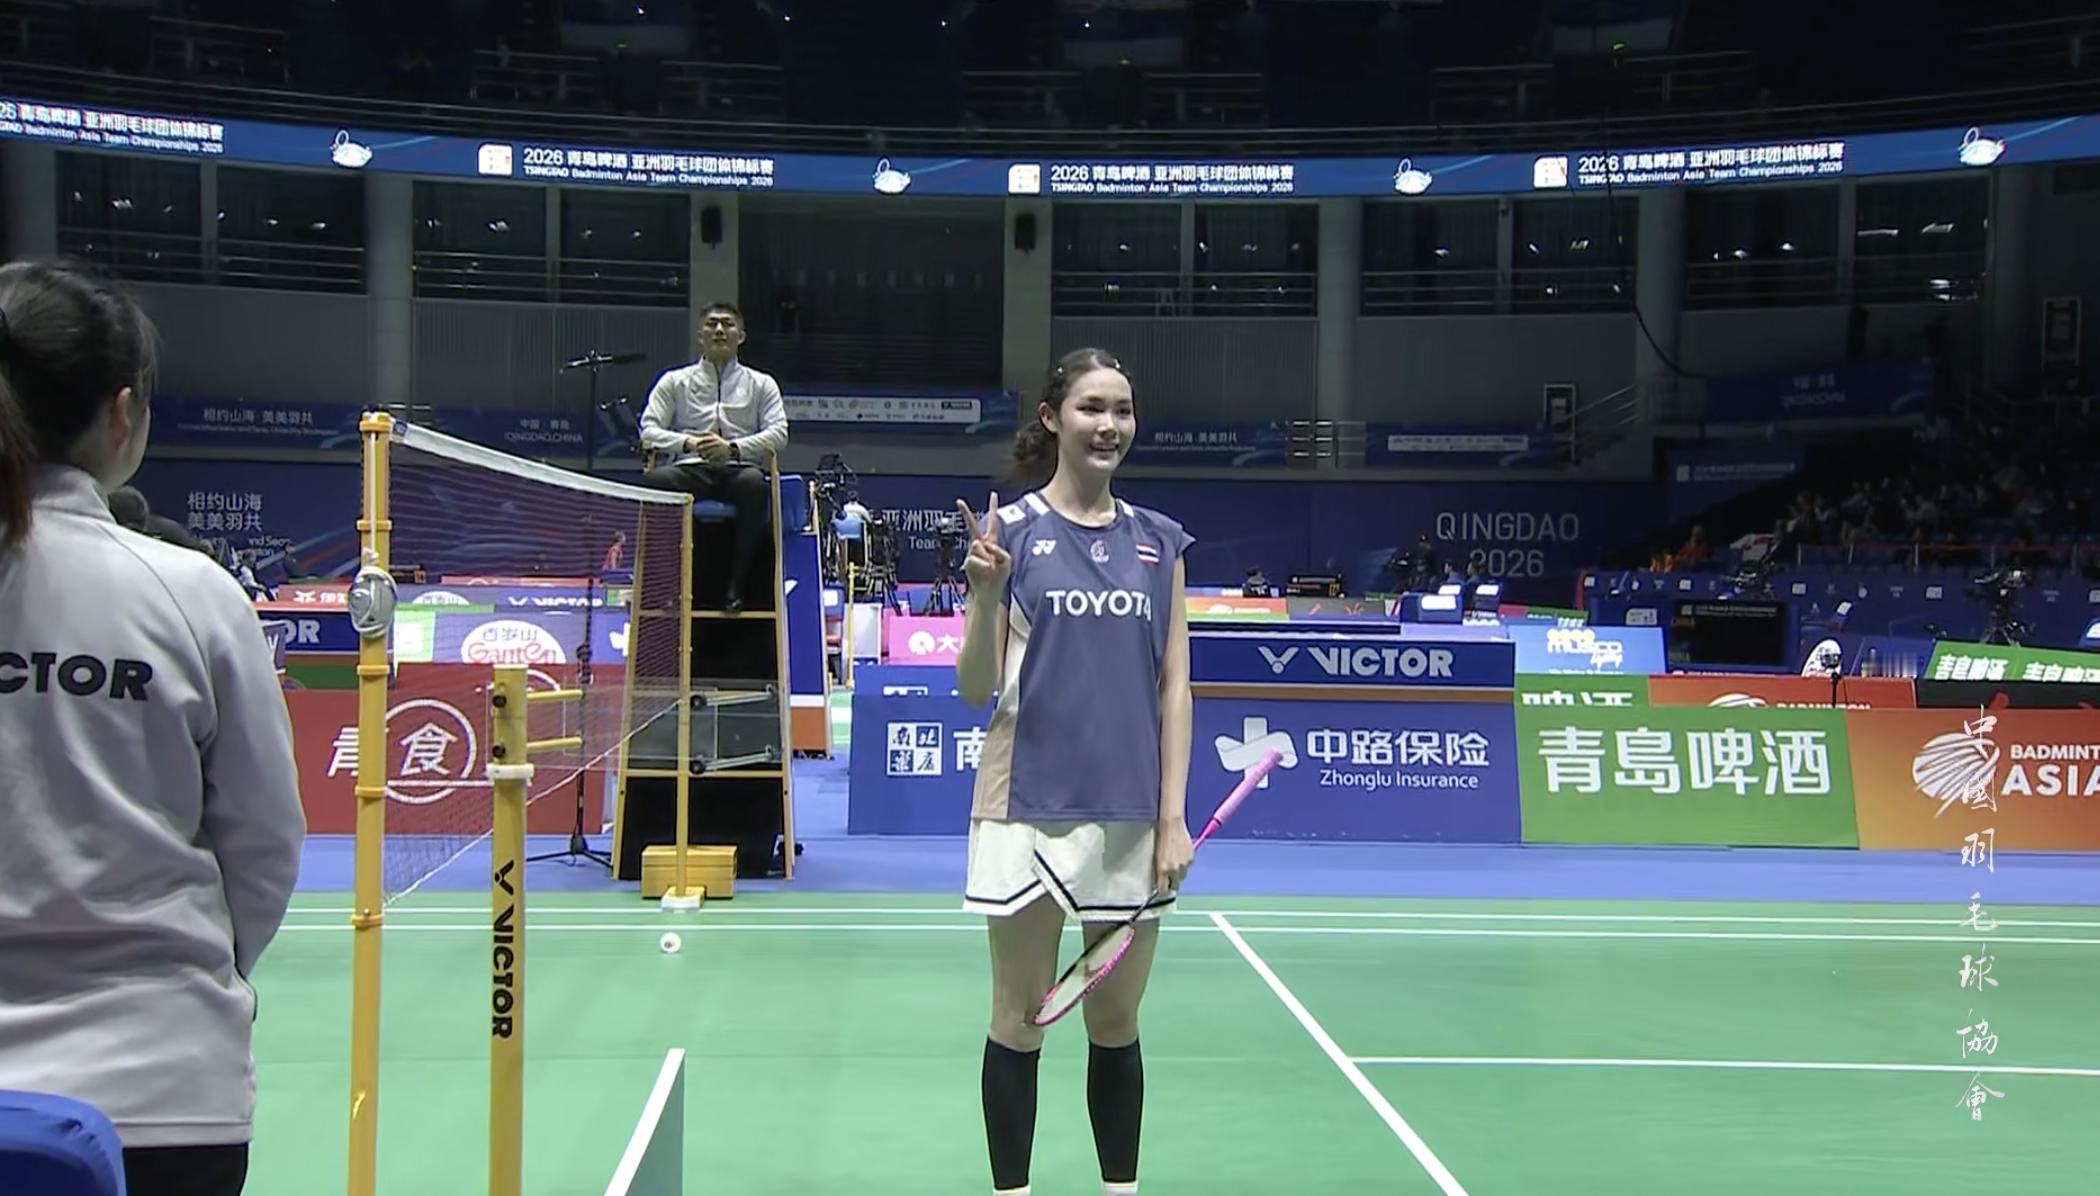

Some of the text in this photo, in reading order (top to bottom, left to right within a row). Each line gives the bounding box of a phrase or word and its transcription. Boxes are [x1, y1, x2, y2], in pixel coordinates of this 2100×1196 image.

[25, 124, 78, 139] Badminton
[80, 130, 101, 142] Asia
[103, 132, 130, 145] Team
[130, 135, 199, 152] Championships
[201, 142, 224, 154] 2026
[523, 148, 564, 166] 2026
[1578, 155, 1619, 173] 2026
[523, 165, 773, 187] TSINGTAO Badminton Asia Team Championships 2026
[1050, 166, 1089, 181] 2026
[1627, 171, 1680, 183] Badminton
[1683, 169, 1704, 180] Asia
[1709, 167, 1736, 179] Team
[1739, 164, 1815, 179] Championships
[1818, 161, 1843, 173] 2026
[1050, 182, 1293, 194] TSINGTAO Badminton Asia Team Championships 2026
[187, 490, 263, 511] 相约山海
[1436, 512, 1580, 541] QINGDAO
[1307, 647, 1454, 677] VICTOR
[0, 652, 153, 701] CTOR
[1307, 727, 1490, 767] 中路保险
[2010, 744, 2100, 760] BADMINT
[1319, 769, 1479, 791] Zhonglu Insurance
[2001, 764, 2100, 797] ASIA
[492, 904, 515, 1039] VICTOR
